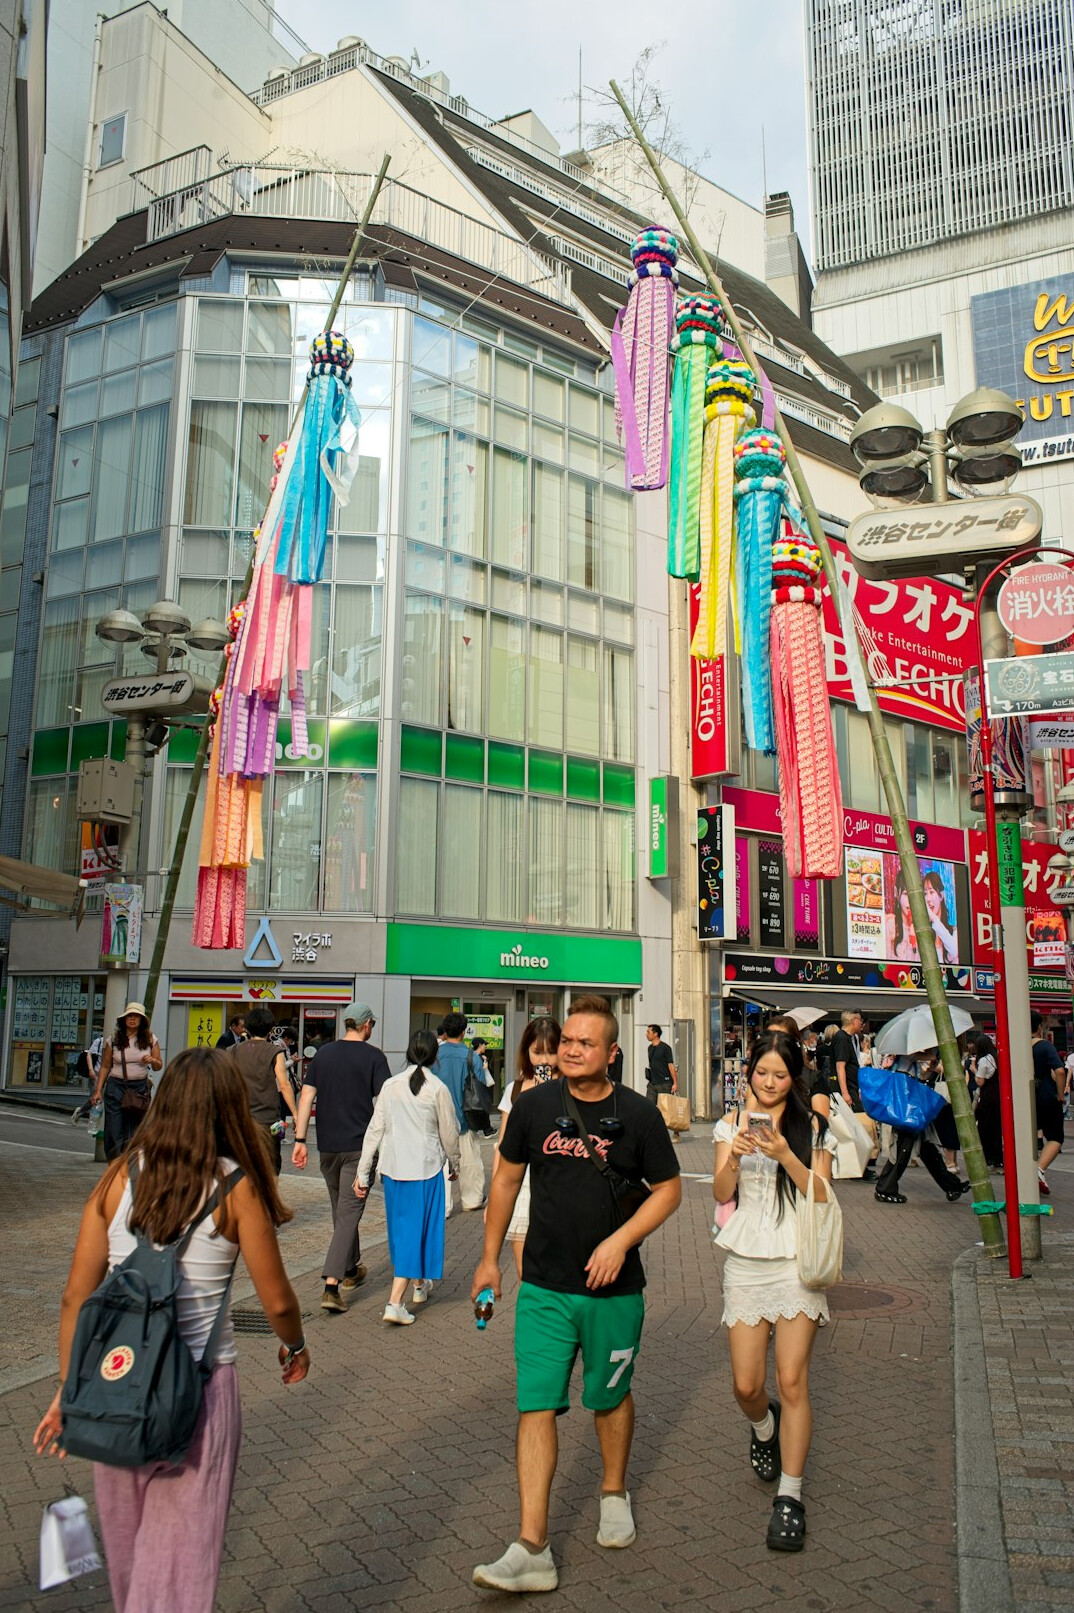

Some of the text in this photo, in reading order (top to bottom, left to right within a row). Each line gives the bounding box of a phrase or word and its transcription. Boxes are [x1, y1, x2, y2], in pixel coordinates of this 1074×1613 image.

[857, 508, 1029, 548] 渋谷センター街
[1011, 571, 1069, 586] FIRE HYDRANT
[888, 632, 963, 668] Entertainment
[104, 679, 187, 701] 渋谷センター街
[697, 670, 716, 741] ECHO
[1016, 701, 1041, 711] 170m
[844, 815, 870, 838] C-pla
[915, 833, 926, 844] 2F
[292, 947, 318, 962] 渋谷
[500, 944, 549, 969] mineo
[742, 964, 756, 972] Capsule
[763, 966, 772, 974] shop
[911, 972, 918, 981] B1
[197, 1017, 214, 1032] よむ
[606, 1346, 635, 1388] 7
